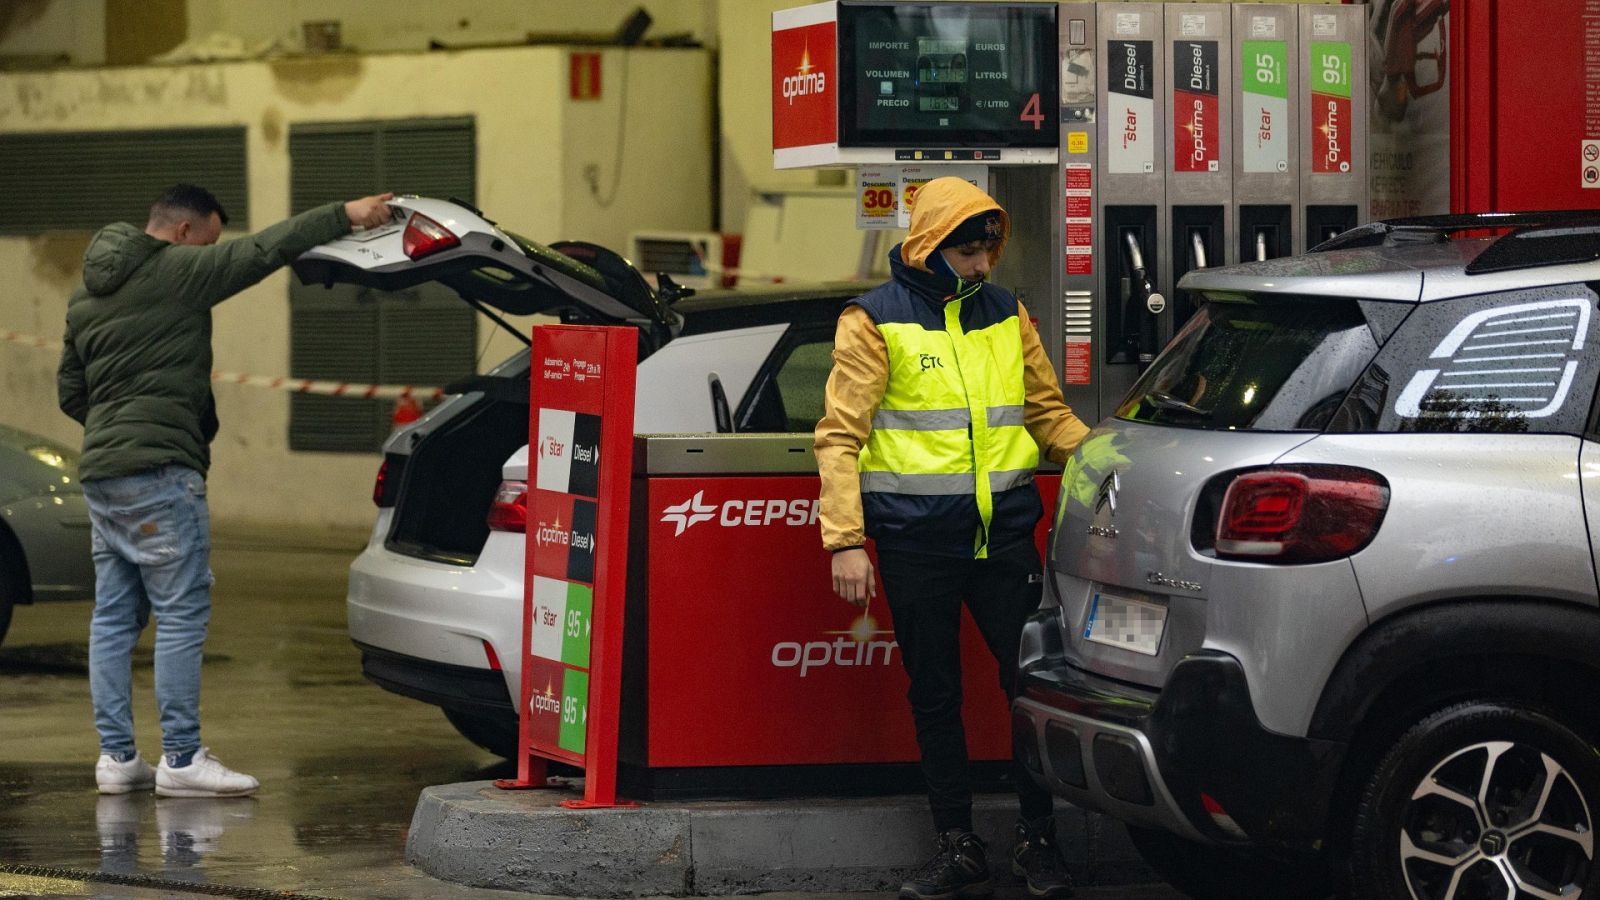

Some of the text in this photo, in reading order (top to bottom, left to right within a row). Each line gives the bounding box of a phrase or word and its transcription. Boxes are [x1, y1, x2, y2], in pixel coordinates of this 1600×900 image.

[869, 41, 910, 50] IMPORTE
[975, 43, 1006, 51] EUROS
[865, 70, 910, 78] VOLUMEN
[975, 71, 1008, 79] LITROS
[1124, 43, 1136, 90] Diesel
[1190, 43, 1202, 90] Diesel
[1256, 54, 1274, 84] 95
[1322, 54, 1340, 84] 95
[782, 71, 826, 105] optima
[877, 99, 910, 107] PRECIO
[1020, 93, 1045, 130] 4
[1127, 108, 1137, 142] star
[1193, 99, 1206, 161] optima
[1261, 107, 1271, 141] star
[1328, 100, 1341, 163] optima
[864, 189, 893, 209] 30
[549, 439, 564, 457] star
[574, 443, 593, 463] Diesel
[541, 527, 569, 547] optima
[571, 530, 590, 549] Diesel
[543, 608, 557, 627] star
[567, 609, 582, 638] 95
[771, 636, 899, 678] optim
[535, 694, 560, 715] optima
[563, 695, 578, 725] 95
